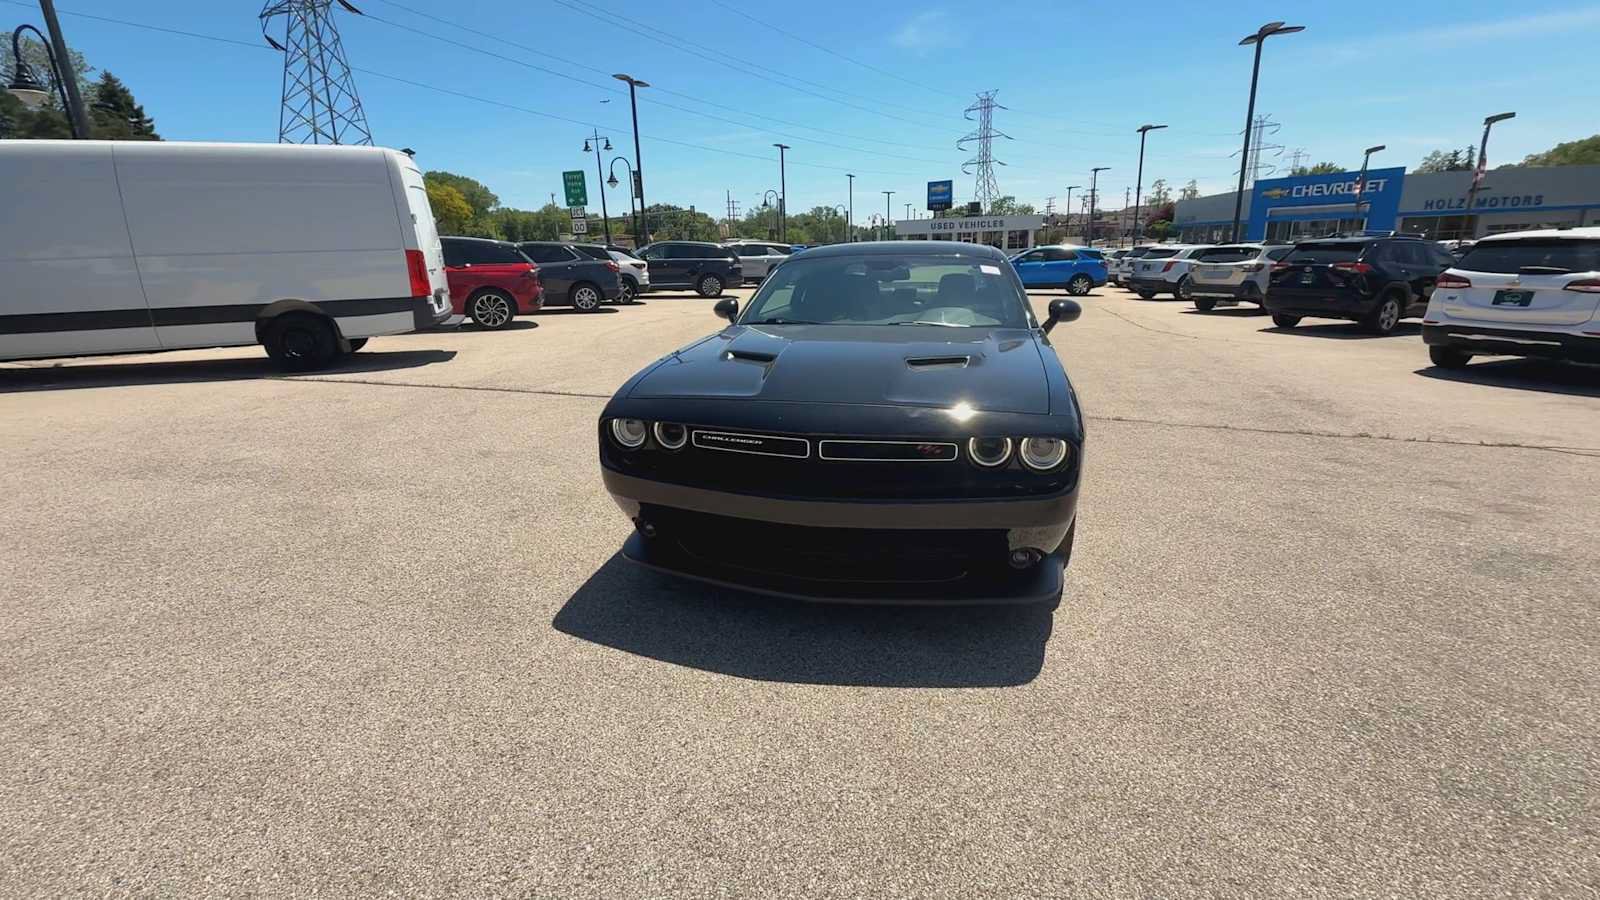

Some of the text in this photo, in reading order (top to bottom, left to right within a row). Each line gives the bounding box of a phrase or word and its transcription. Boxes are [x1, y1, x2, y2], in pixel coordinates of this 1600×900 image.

[1292, 179, 1388, 198] CHEVROET
[1424, 195, 1544, 210] HOLZ MOTORS
[930, 219, 1004, 230] USED VEHICLES
[702, 435, 763, 445] CHALLENGER
